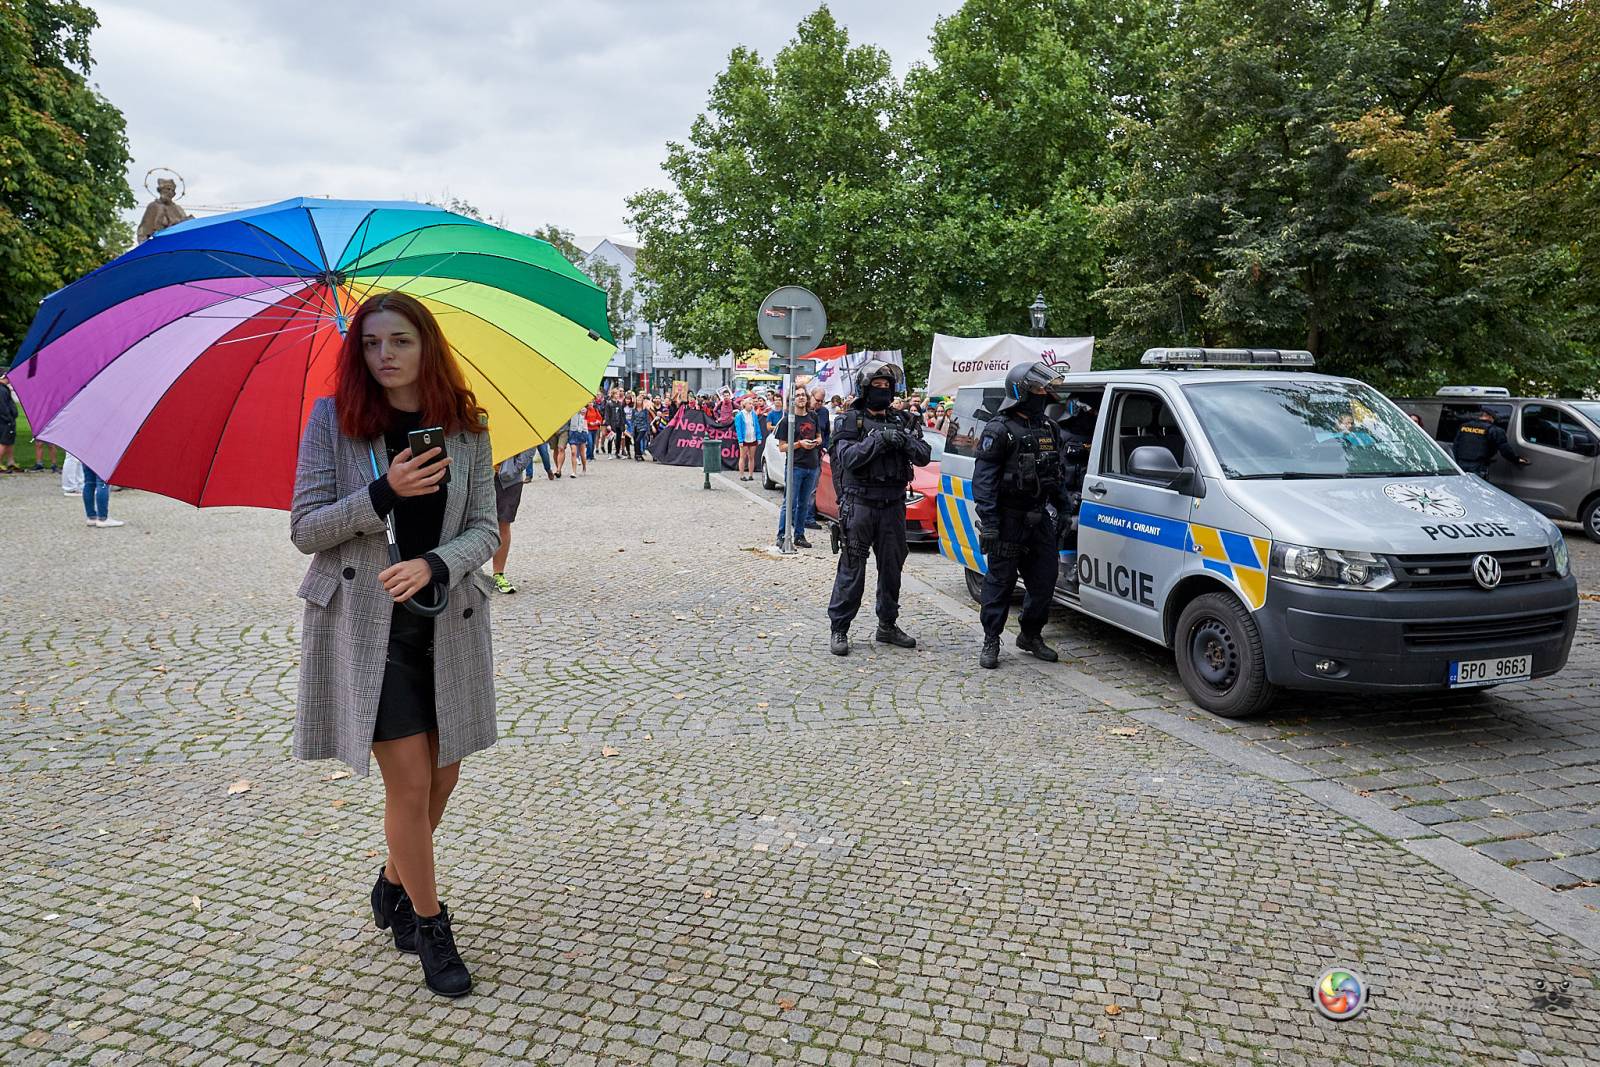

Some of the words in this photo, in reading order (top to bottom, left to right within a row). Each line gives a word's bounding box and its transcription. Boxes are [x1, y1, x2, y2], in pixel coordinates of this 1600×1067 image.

[1460, 426, 1486, 435] POLICIE
[1097, 513, 1126, 528] POMÁHAT
[1126, 522, 1132, 530] A
[1421, 523, 1516, 541] POLICIE
[1078, 553, 1155, 608] OLICIE
[1496, 657, 1527, 677] 9663
